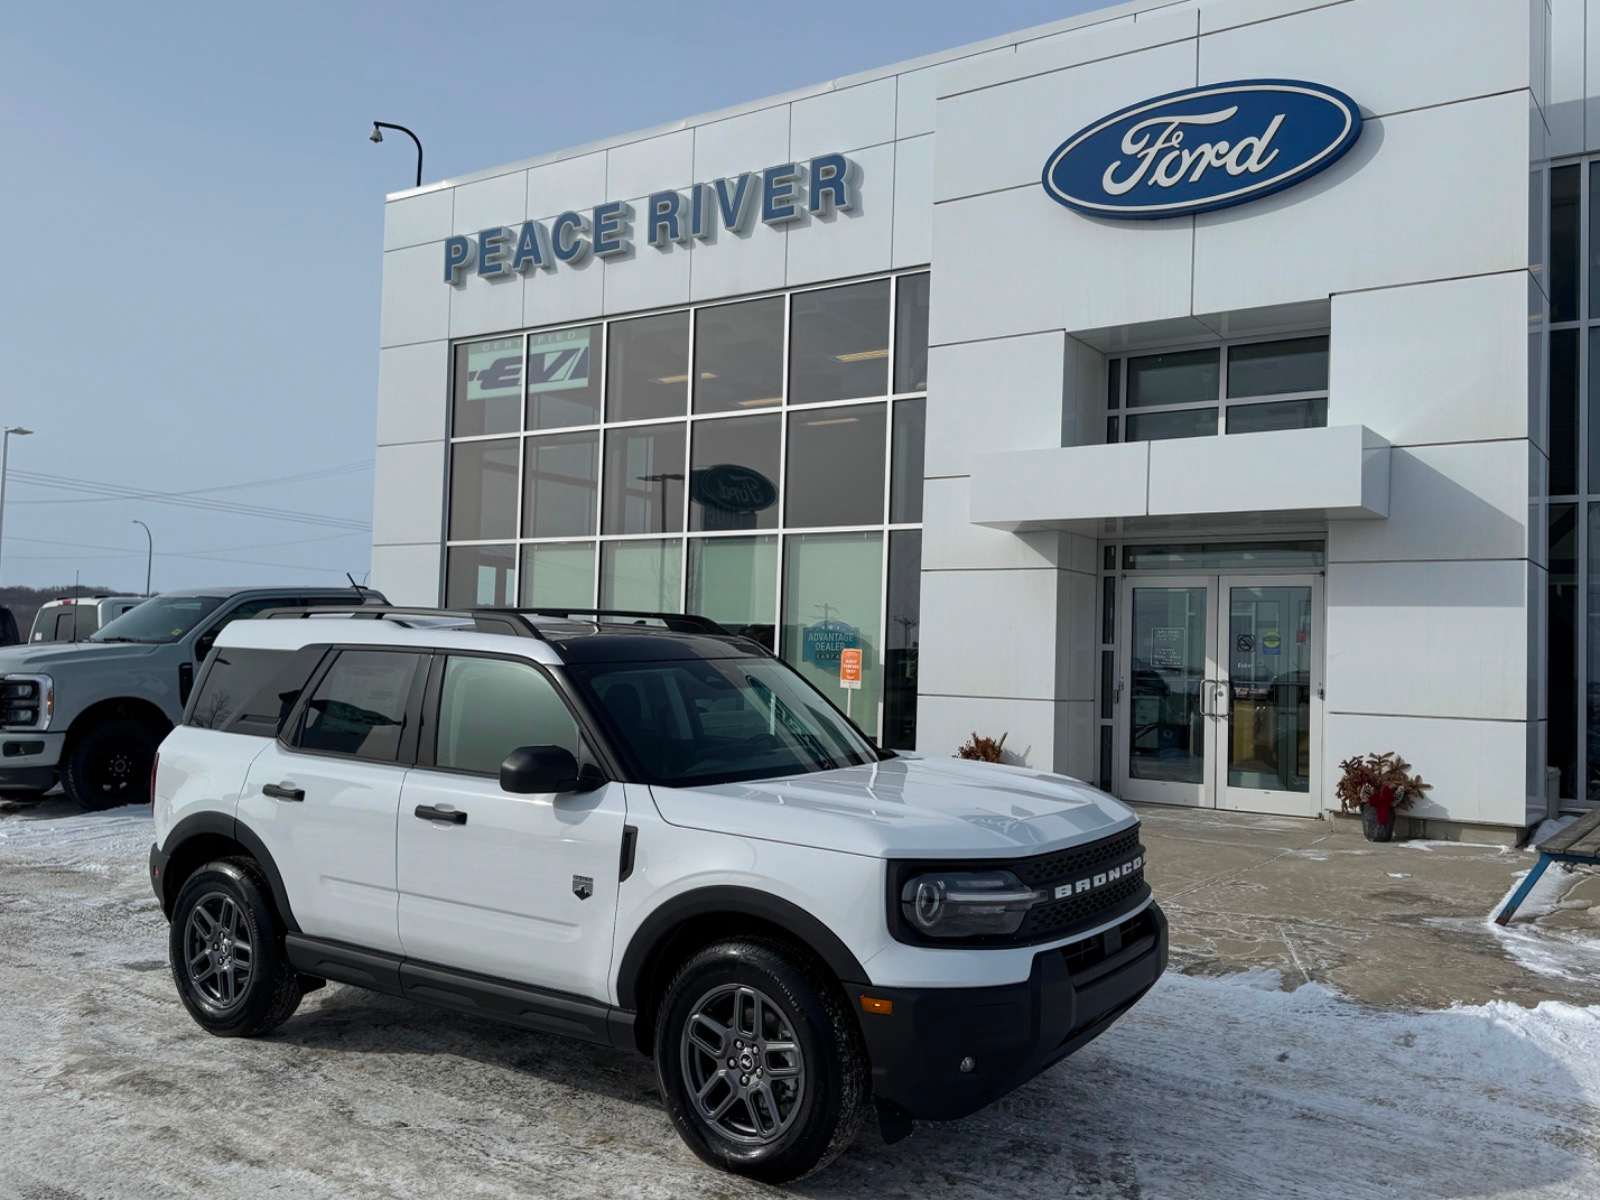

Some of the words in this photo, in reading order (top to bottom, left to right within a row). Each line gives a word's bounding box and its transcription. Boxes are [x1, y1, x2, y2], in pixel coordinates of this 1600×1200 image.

[1102, 105, 1286, 196] Ford
[444, 200, 628, 285] PEACE
[648, 152, 855, 248] RIVER
[482, 331, 576, 351] CERTFIED
[808, 632, 853, 642] ADVANTAGE
[815, 642, 845, 652] DEALER
[1054, 856, 1143, 900] BRONCO
